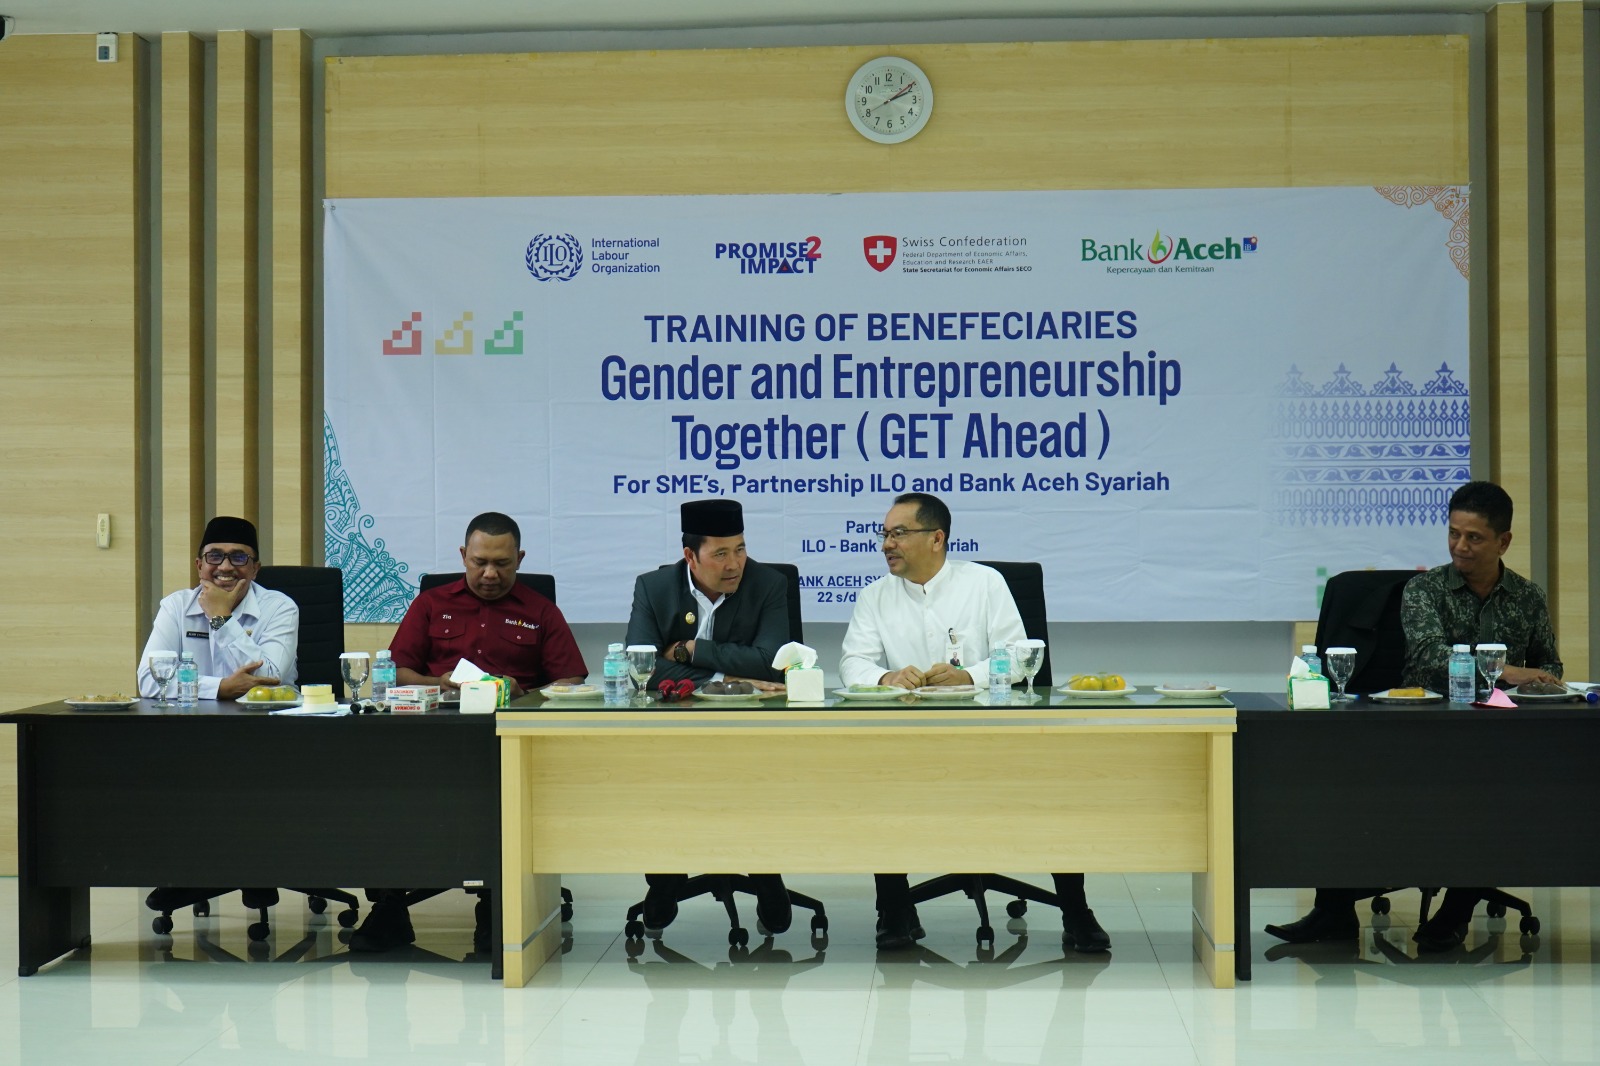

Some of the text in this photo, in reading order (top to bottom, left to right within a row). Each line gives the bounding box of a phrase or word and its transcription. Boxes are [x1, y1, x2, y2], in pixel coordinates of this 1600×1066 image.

[874, 76, 880, 86] 11
[885, 73, 892, 82] 12
[866, 86, 872, 94] 10
[862, 97, 867, 106] 9
[912, 96, 917, 104] 3
[866, 108, 871, 118] 8
[908, 108, 913, 116] 4
[875, 116, 880, 126] 7
[886, 120, 892, 128] 6
[900, 116, 905, 124] 5
[592, 238, 660, 248] International
[902, 236, 1027, 247] Swiss Confederation
[716, 236, 822, 258] PROMISE 2
[1081, 236, 1242, 261] Bank Aceh
[543, 243, 567, 266] ILO
[592, 251, 629, 260] Labour
[592, 263, 660, 275] Organization
[1106, 266, 1156, 274] Kepercayaan
[644, 310, 1138, 343] TRAINING OF BENEFECIARIES
[602, 350, 1181, 405] Gender and Entrepreneurship
[672, 414, 846, 470] Together
[962, 412, 1086, 458] Ahead
[614, 472, 1170, 496] For SME's, Partnership ILO and Bank Aceh Syariah
[802, 540, 826, 552] ILO
[840, 540, 876, 552] Bank
[800, 576, 823, 586] ANK
[827, 576, 862, 586] ACEH
[818, 592, 856, 602] 22 s/d
